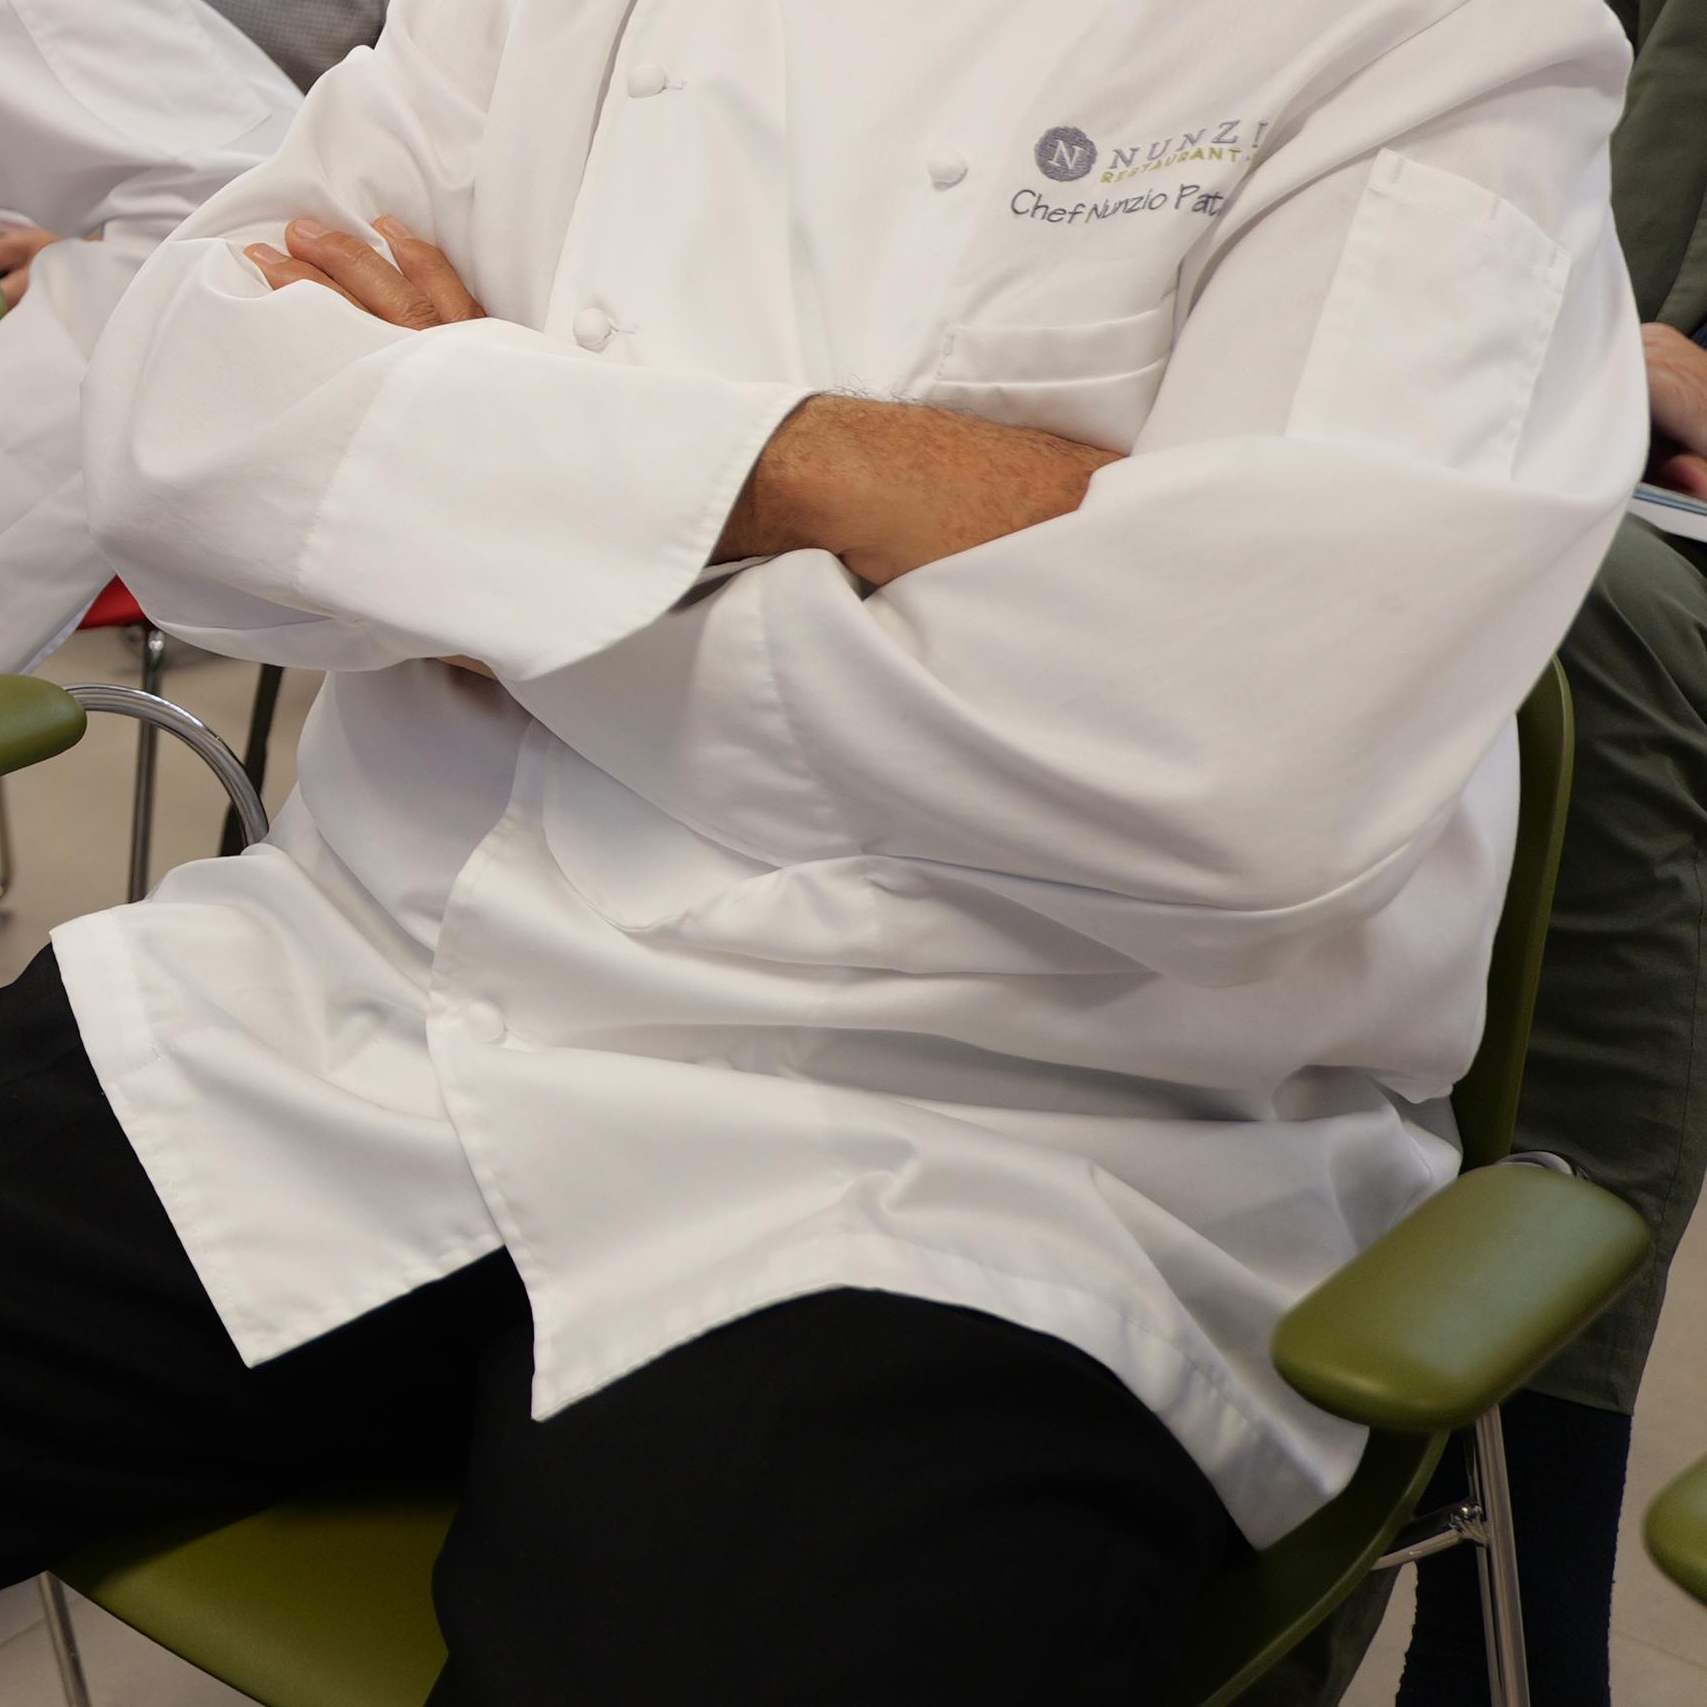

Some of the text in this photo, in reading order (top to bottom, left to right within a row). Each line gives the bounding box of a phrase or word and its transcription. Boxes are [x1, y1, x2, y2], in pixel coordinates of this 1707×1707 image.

[1099, 147, 1243, 184] RESTAURANT
[1010, 188, 1086, 225] Chef
[1085, 188, 1168, 225] Nunzio
